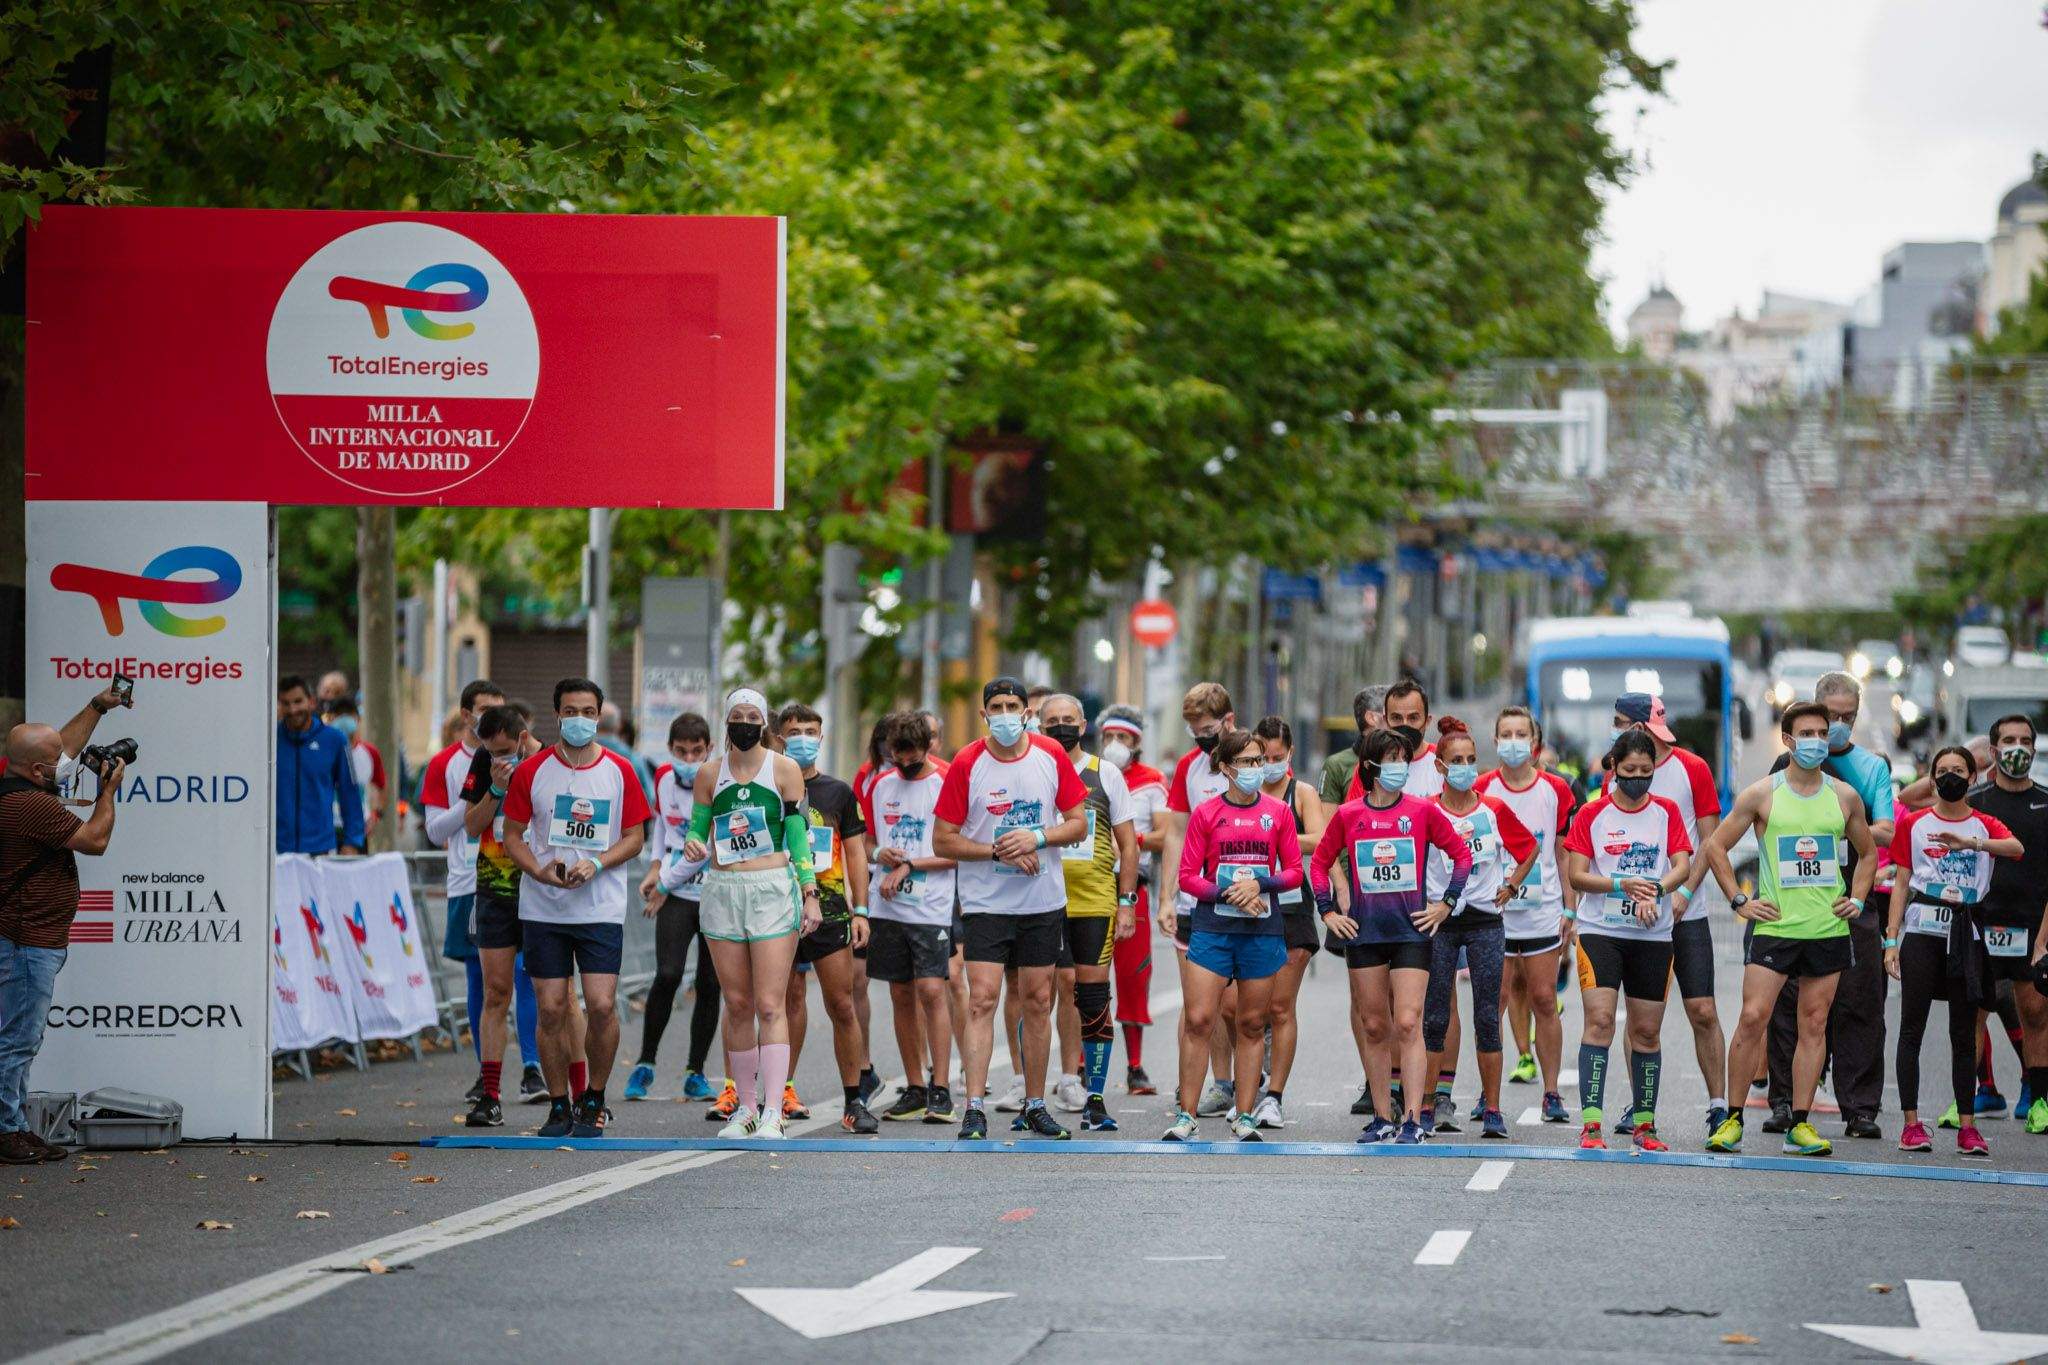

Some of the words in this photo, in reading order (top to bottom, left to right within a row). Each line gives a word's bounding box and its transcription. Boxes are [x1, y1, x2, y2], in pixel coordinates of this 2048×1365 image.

[328, 355, 488, 380] TotalEnergies
[366, 404, 443, 423] MILLA
[338, 452, 371, 470] DE
[376, 453, 470, 471] MADRID
[50, 655, 243, 685] TotalEnergies
[565, 821, 596, 840] 506
[729, 833, 758, 852] 483
[122, 873, 149, 884] new
[151, 872, 205, 884] balance
[1372, 865, 1402, 882] 493
[1795, 860, 1822, 877] 183
[122, 889, 228, 914] MILLA
[123, 919, 244, 943] URBANA
[1988, 931, 2014, 948] 527
